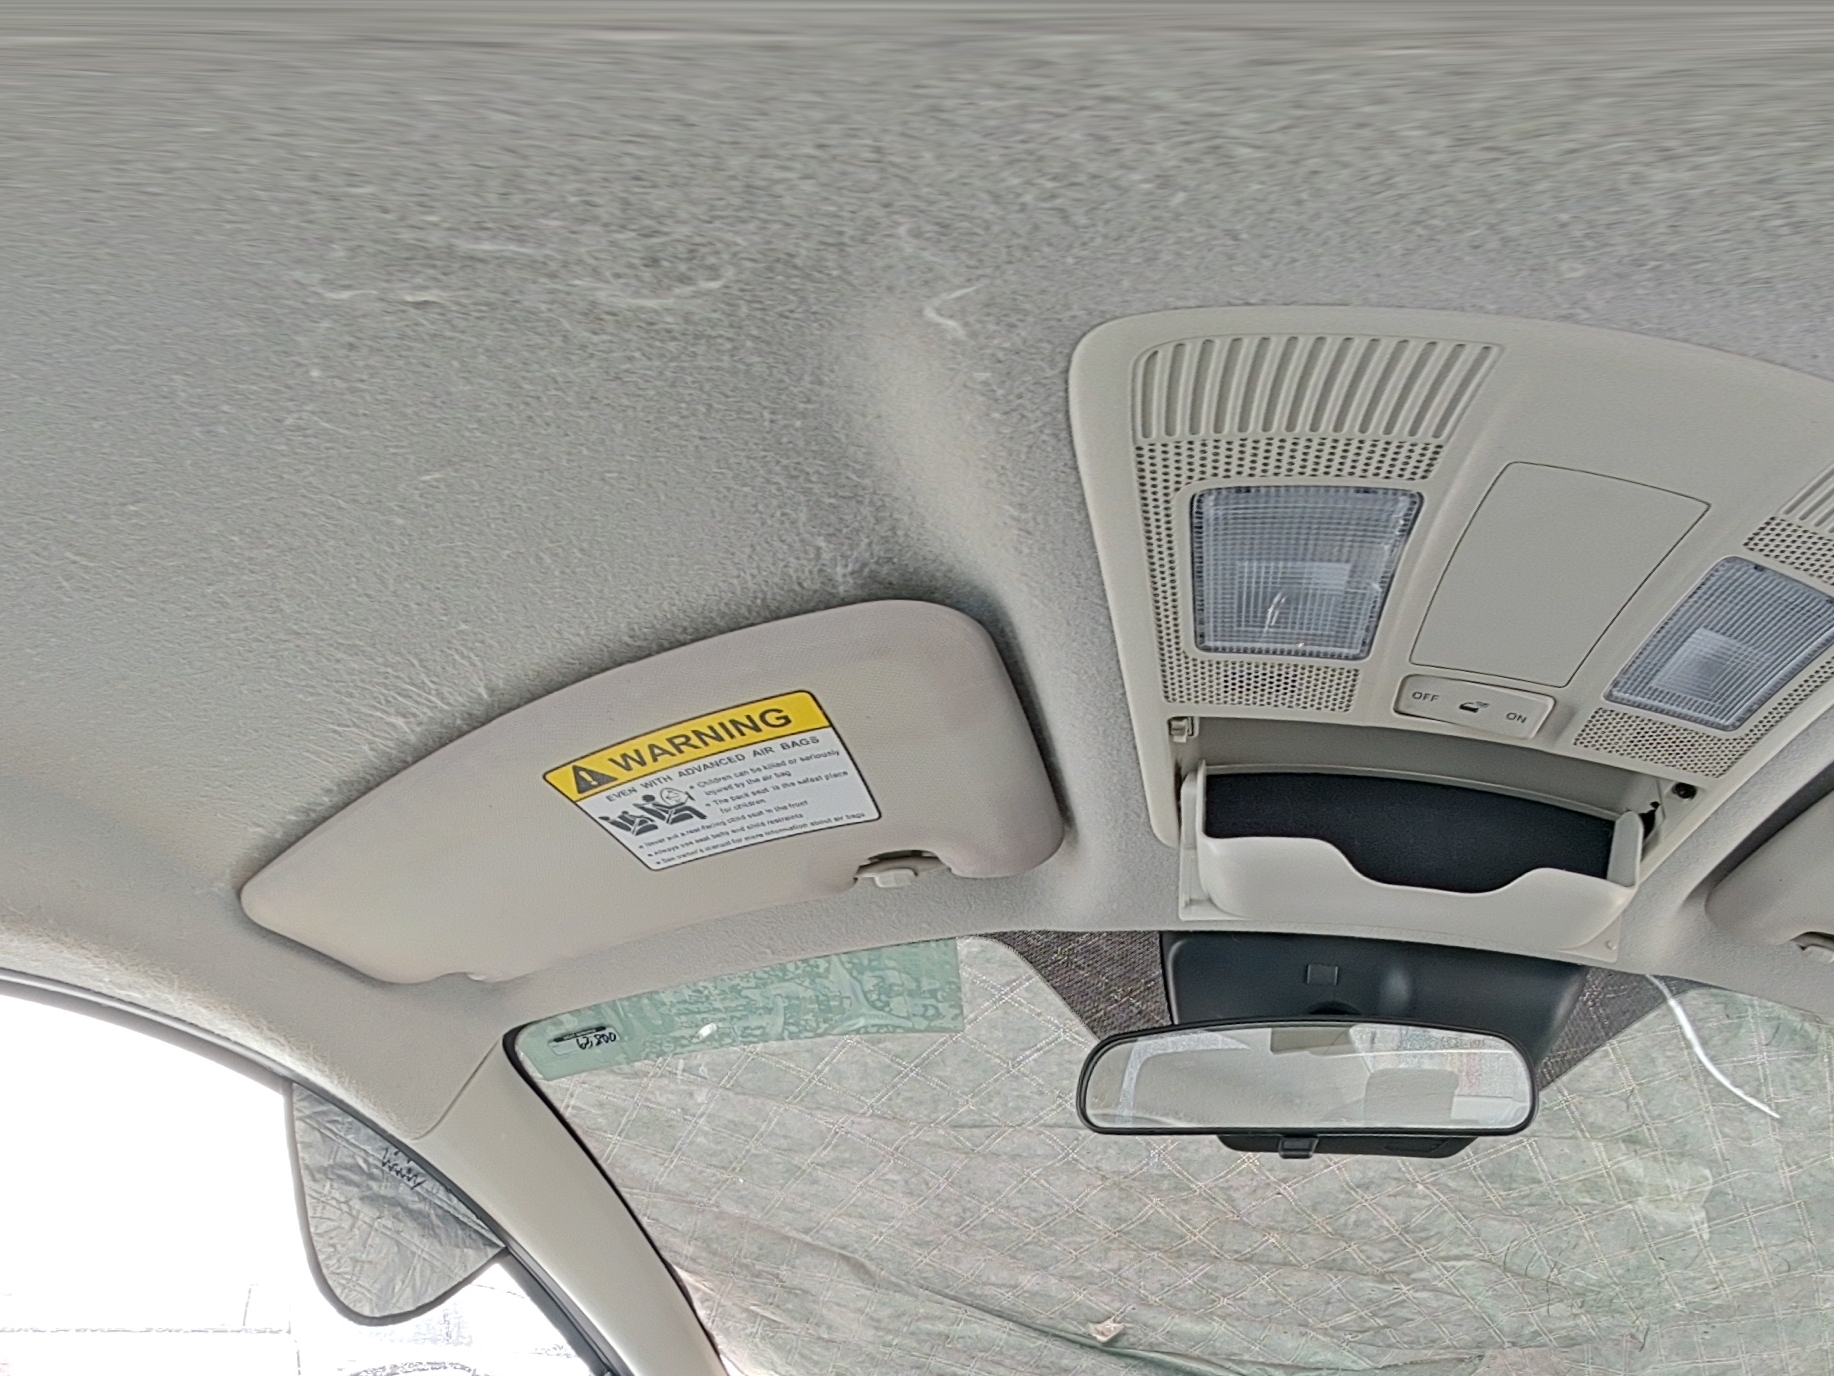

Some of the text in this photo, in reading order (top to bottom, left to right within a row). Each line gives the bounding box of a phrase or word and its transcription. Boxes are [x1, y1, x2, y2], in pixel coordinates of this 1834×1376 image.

[608, 707, 792, 772] WARNING
[1412, 691, 1527, 723] OFF ON
[605, 735, 820, 802] EVEN WITH ADVANCED AIR BAGS
